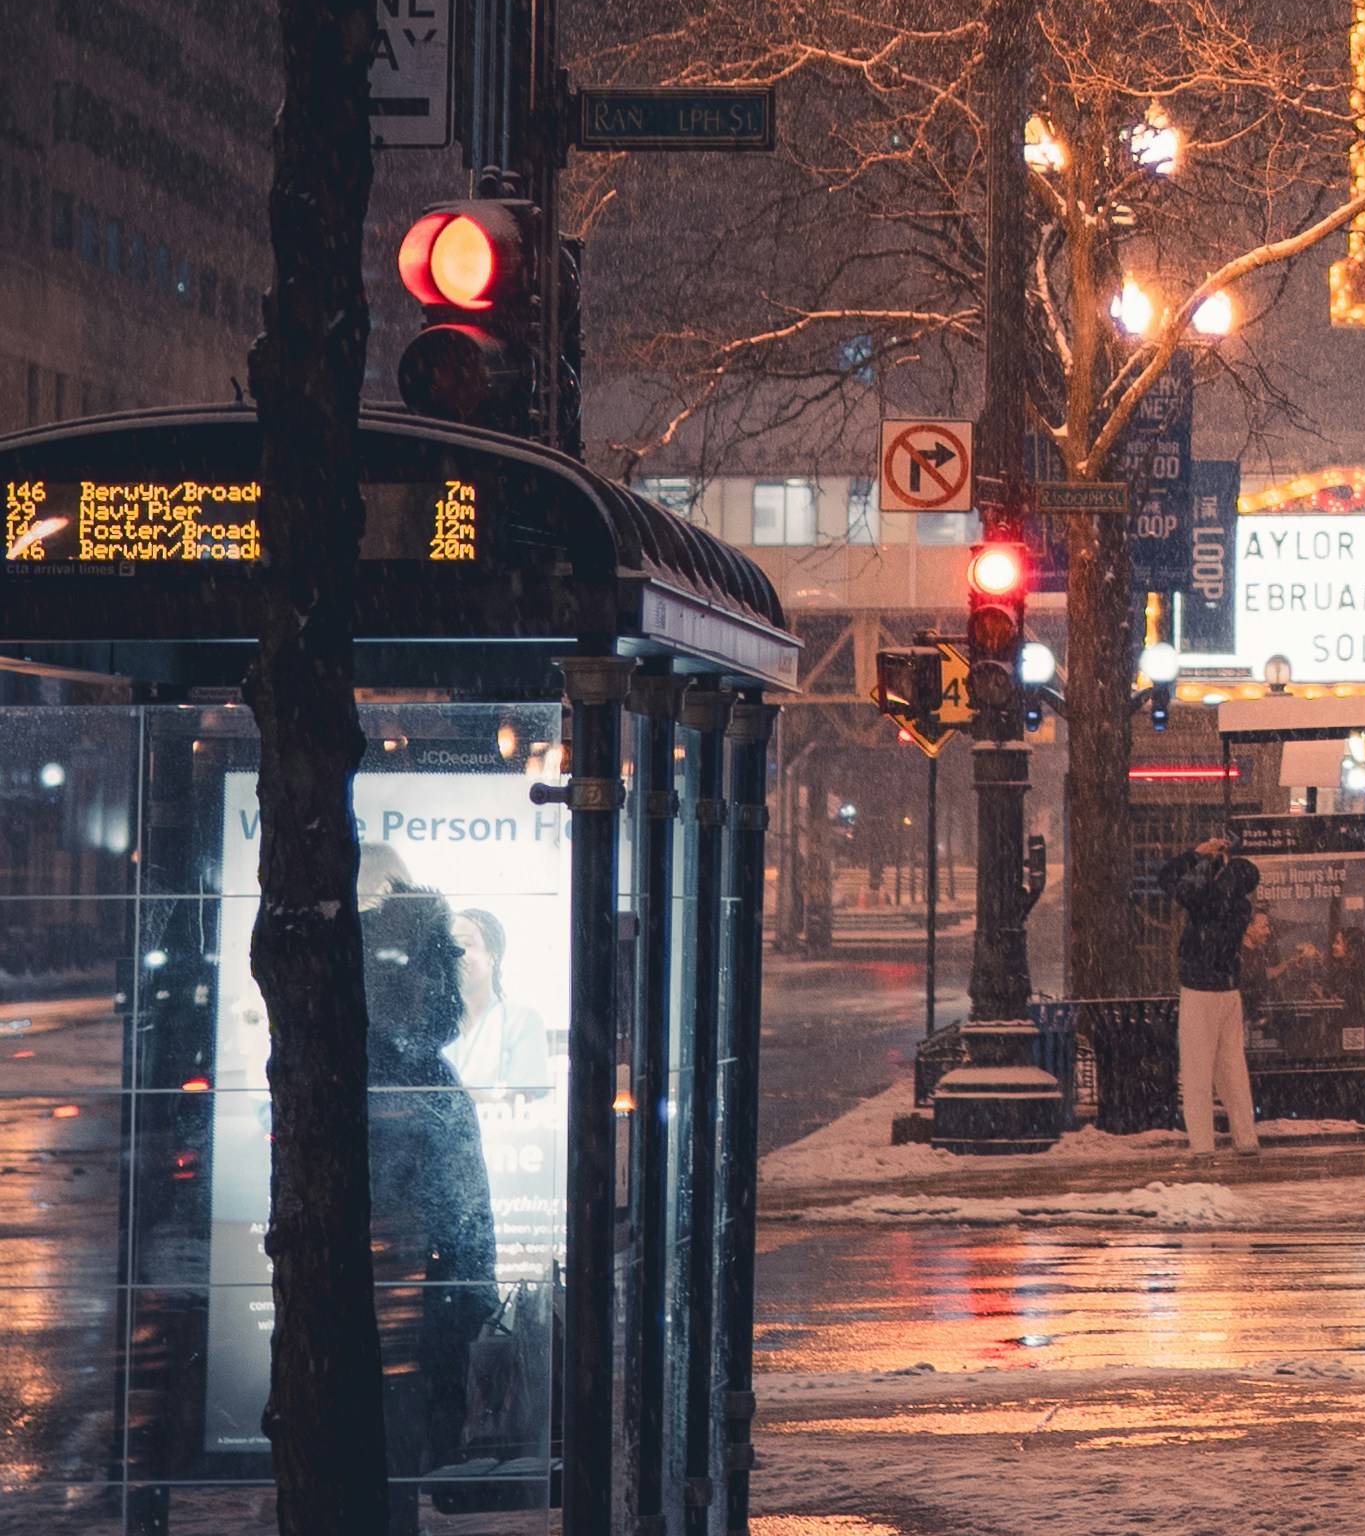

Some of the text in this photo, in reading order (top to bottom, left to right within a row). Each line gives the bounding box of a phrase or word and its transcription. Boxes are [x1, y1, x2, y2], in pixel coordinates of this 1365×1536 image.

[594, 102, 721, 132] RANLPH
[6, 481, 46, 502] 146
[444, 481, 475, 502] 7m
[6, 501, 475, 523] 29 Navy Pier 10m
[79, 520, 261, 540] Foster/Broad
[433, 521, 475, 541] 12m
[430, 540, 475, 560] 20m
[1244, 530, 1356, 562] AYLOR
[6, 561, 114, 574] cta arrival times
[417, 750, 497, 765] JCDecaux
[382, 809, 517, 841] Person
[1327, 865, 1347, 881] Are
[1314, 883, 1342, 898] Here
